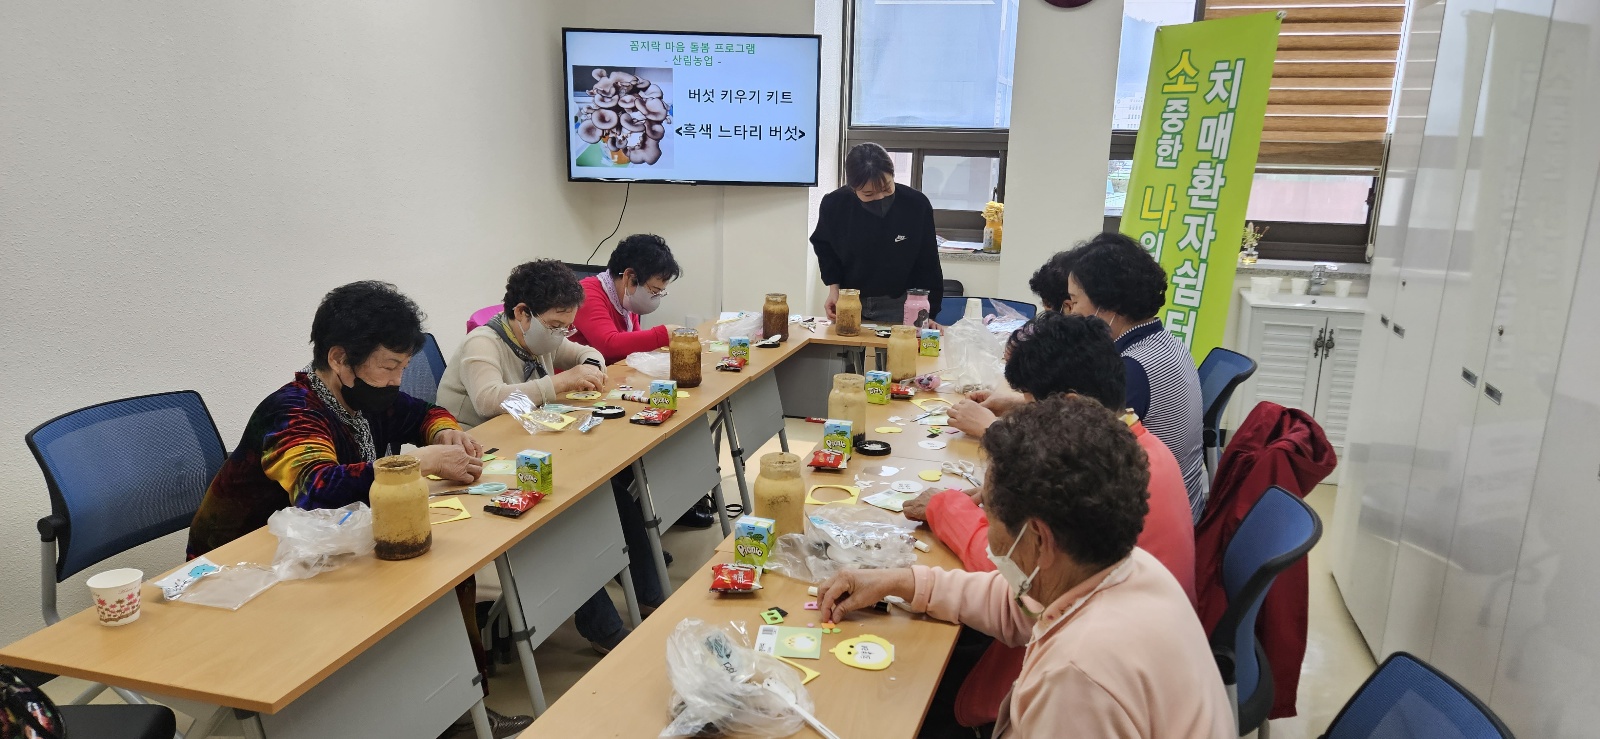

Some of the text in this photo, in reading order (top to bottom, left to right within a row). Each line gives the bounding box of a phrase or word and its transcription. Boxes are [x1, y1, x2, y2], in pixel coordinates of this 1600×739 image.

[629, 40, 756, 55] 꼼지락 마음 돌봄 프로그램
[672, 55, 714, 67] 산림농업
[688, 89, 793, 105] 버섯 키우기 키트
[1155, 49, 1200, 168] 소중한
[675, 123, 806, 142] <흑색 느타리 버섯>
[1164, 58, 1246, 350] 치매환자쉼터
[737, 544, 764, 557] Picnic
